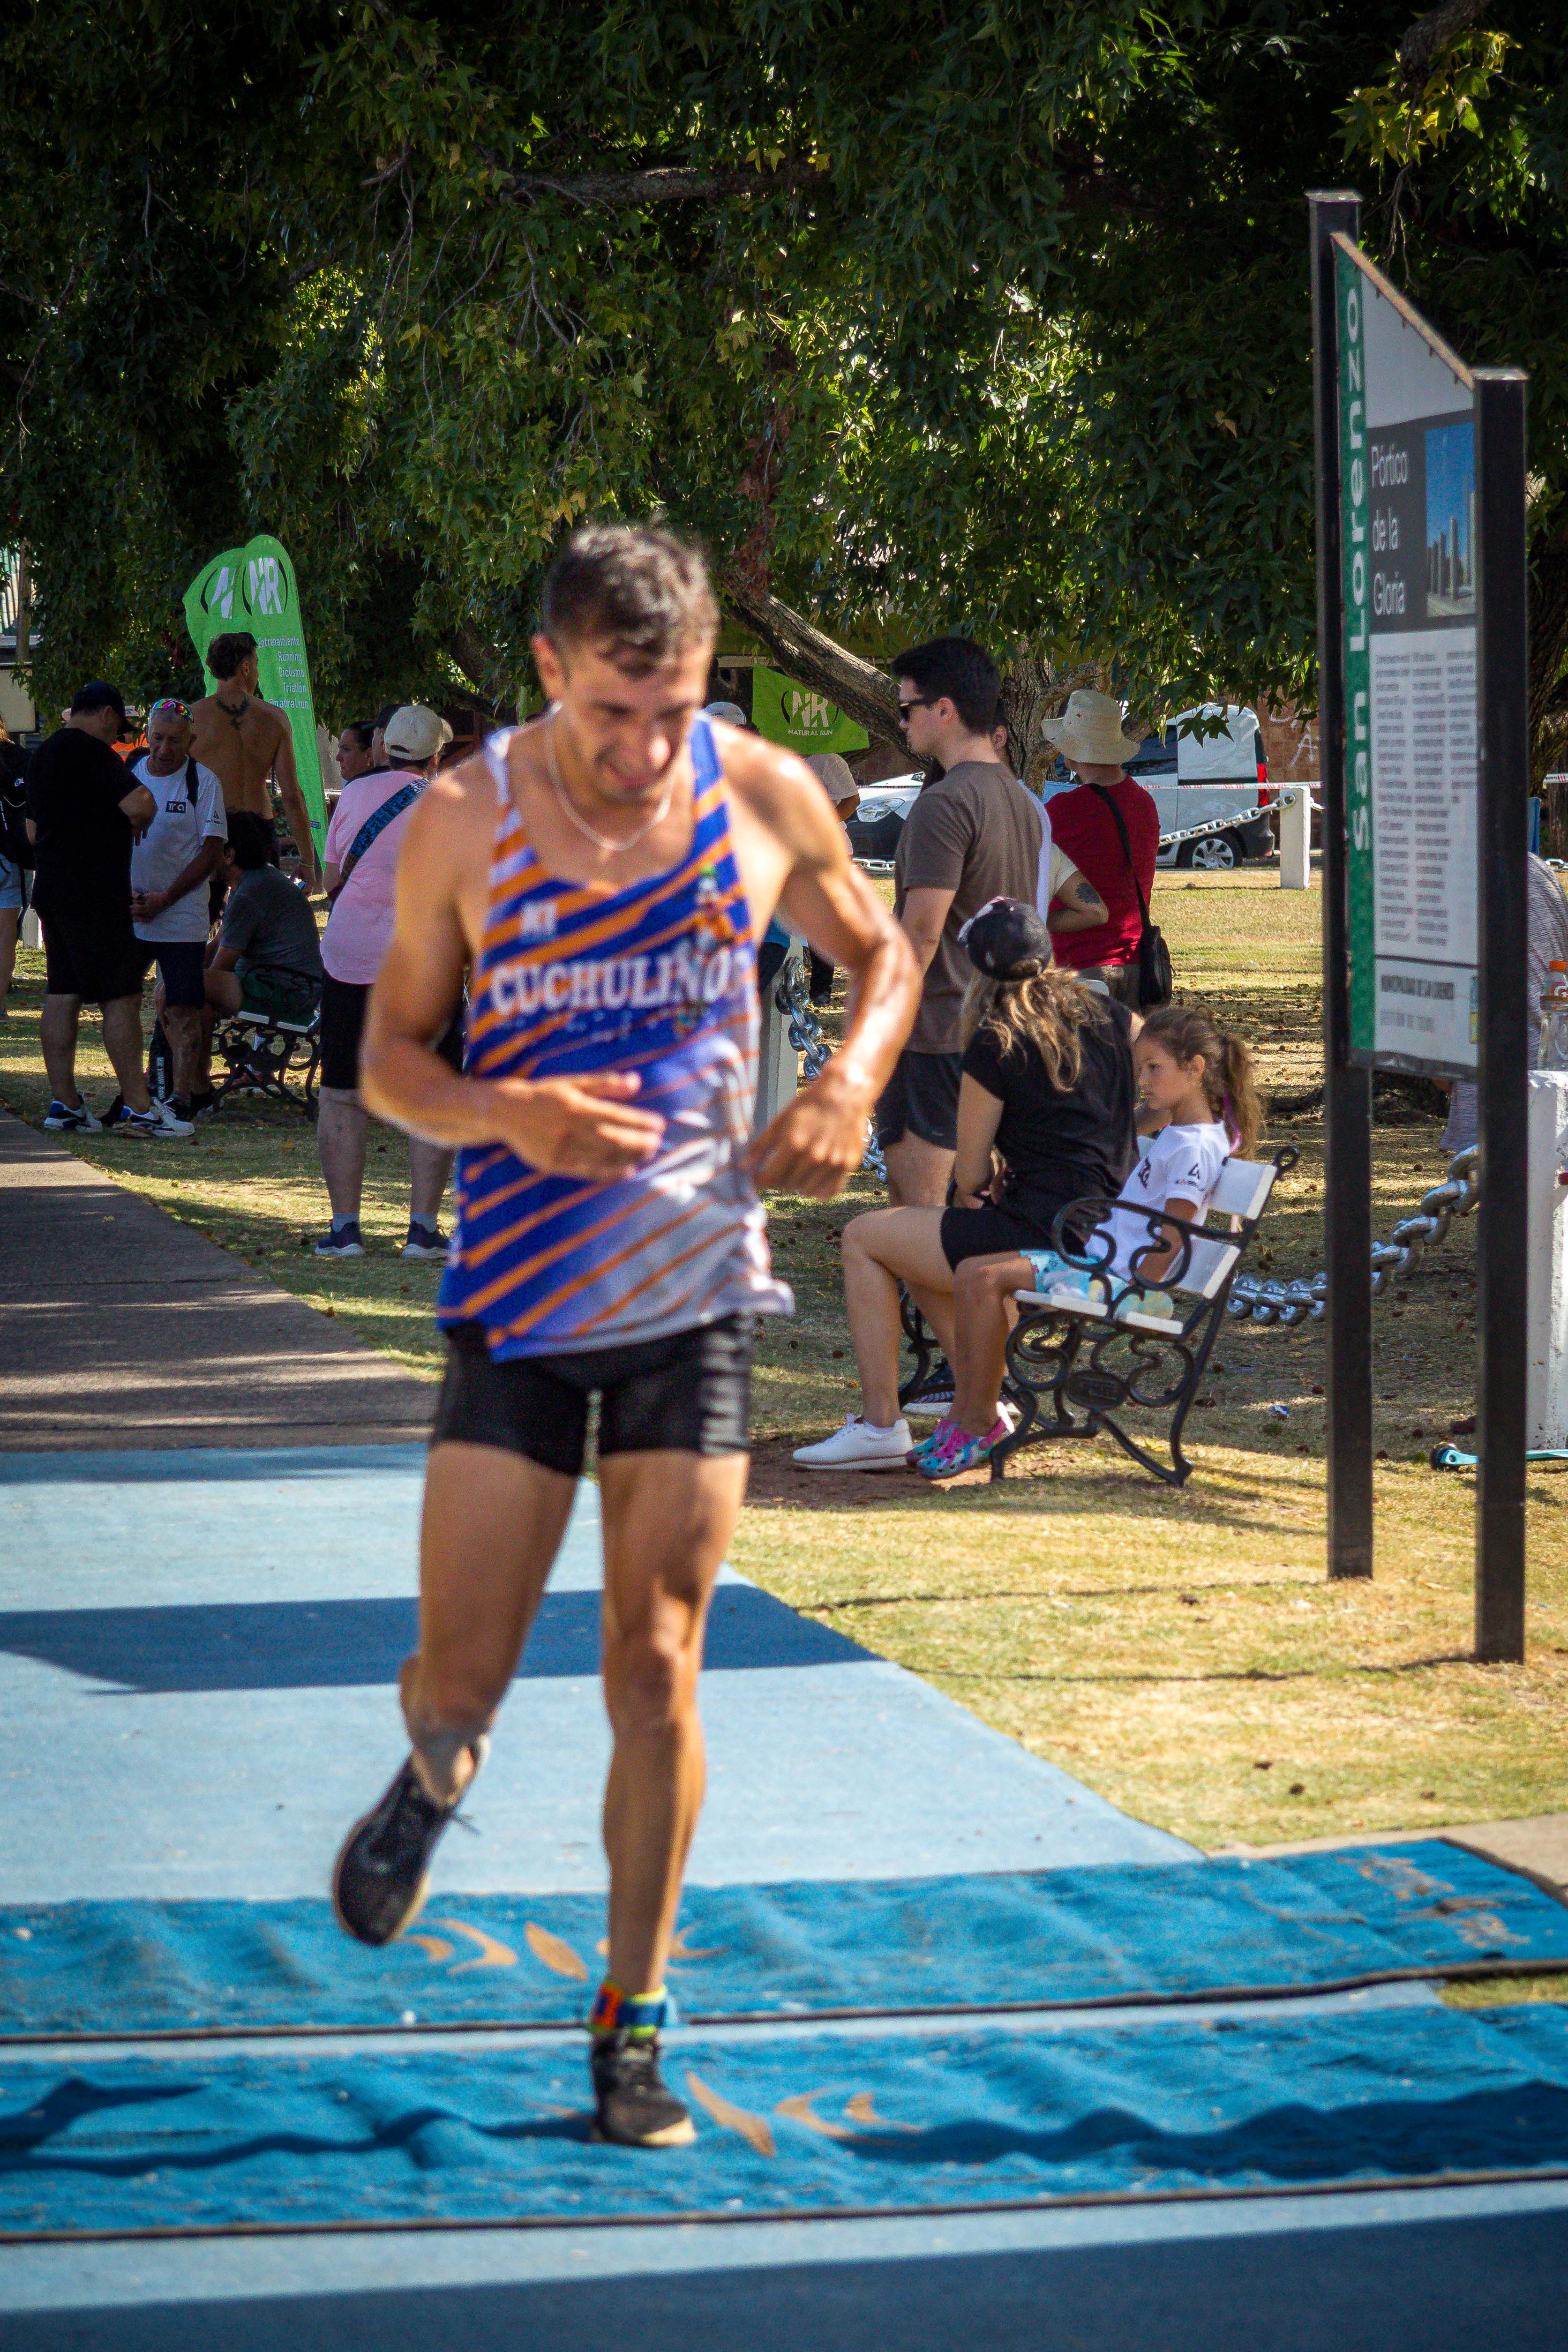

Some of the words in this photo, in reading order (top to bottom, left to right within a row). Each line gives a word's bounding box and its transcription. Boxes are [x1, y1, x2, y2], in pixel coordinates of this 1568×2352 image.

[1347, 289, 1365, 651] Lorenzo
[1372, 509, 1386, 551] de
[1388, 508, 1399, 550] la
[1373, 571, 1405, 616] Gloria
[258, 636, 300, 649] Entrenamiento
[278, 651, 302, 664] Running
[278, 667, 304, 678] Ciclismo
[283, 682, 307, 693] Triatlón
